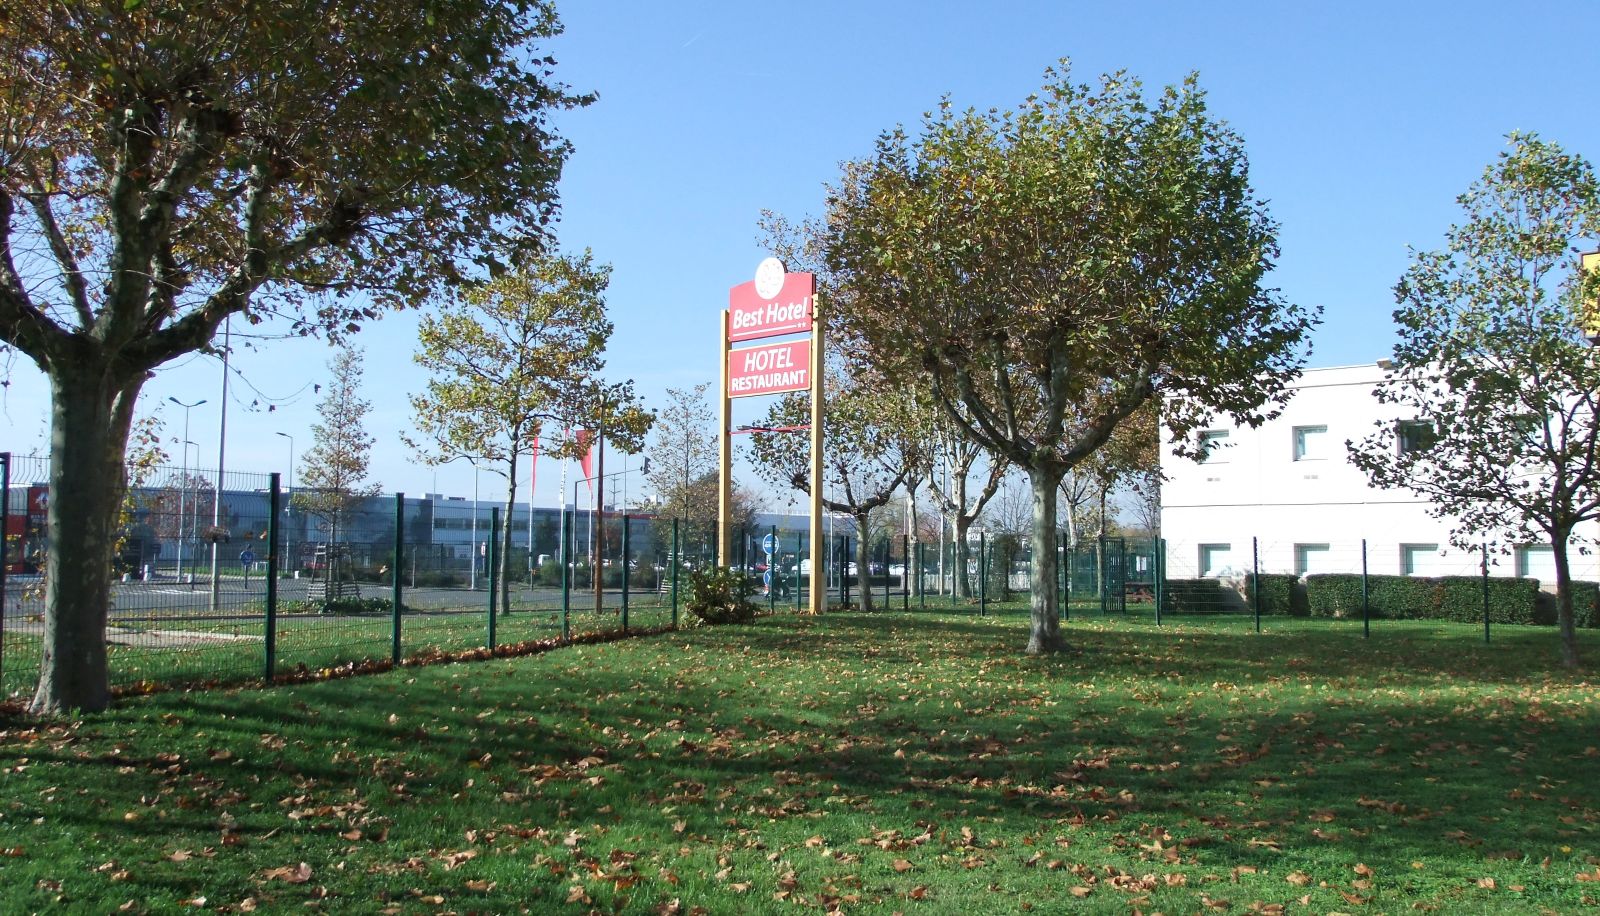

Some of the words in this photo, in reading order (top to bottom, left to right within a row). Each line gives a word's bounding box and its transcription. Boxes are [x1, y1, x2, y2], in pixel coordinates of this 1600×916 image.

[733, 306, 764, 329] Best
[766, 297, 808, 324] Hotel
[744, 347, 793, 372] HOTEL
[732, 370, 806, 391] RESTAURANT
